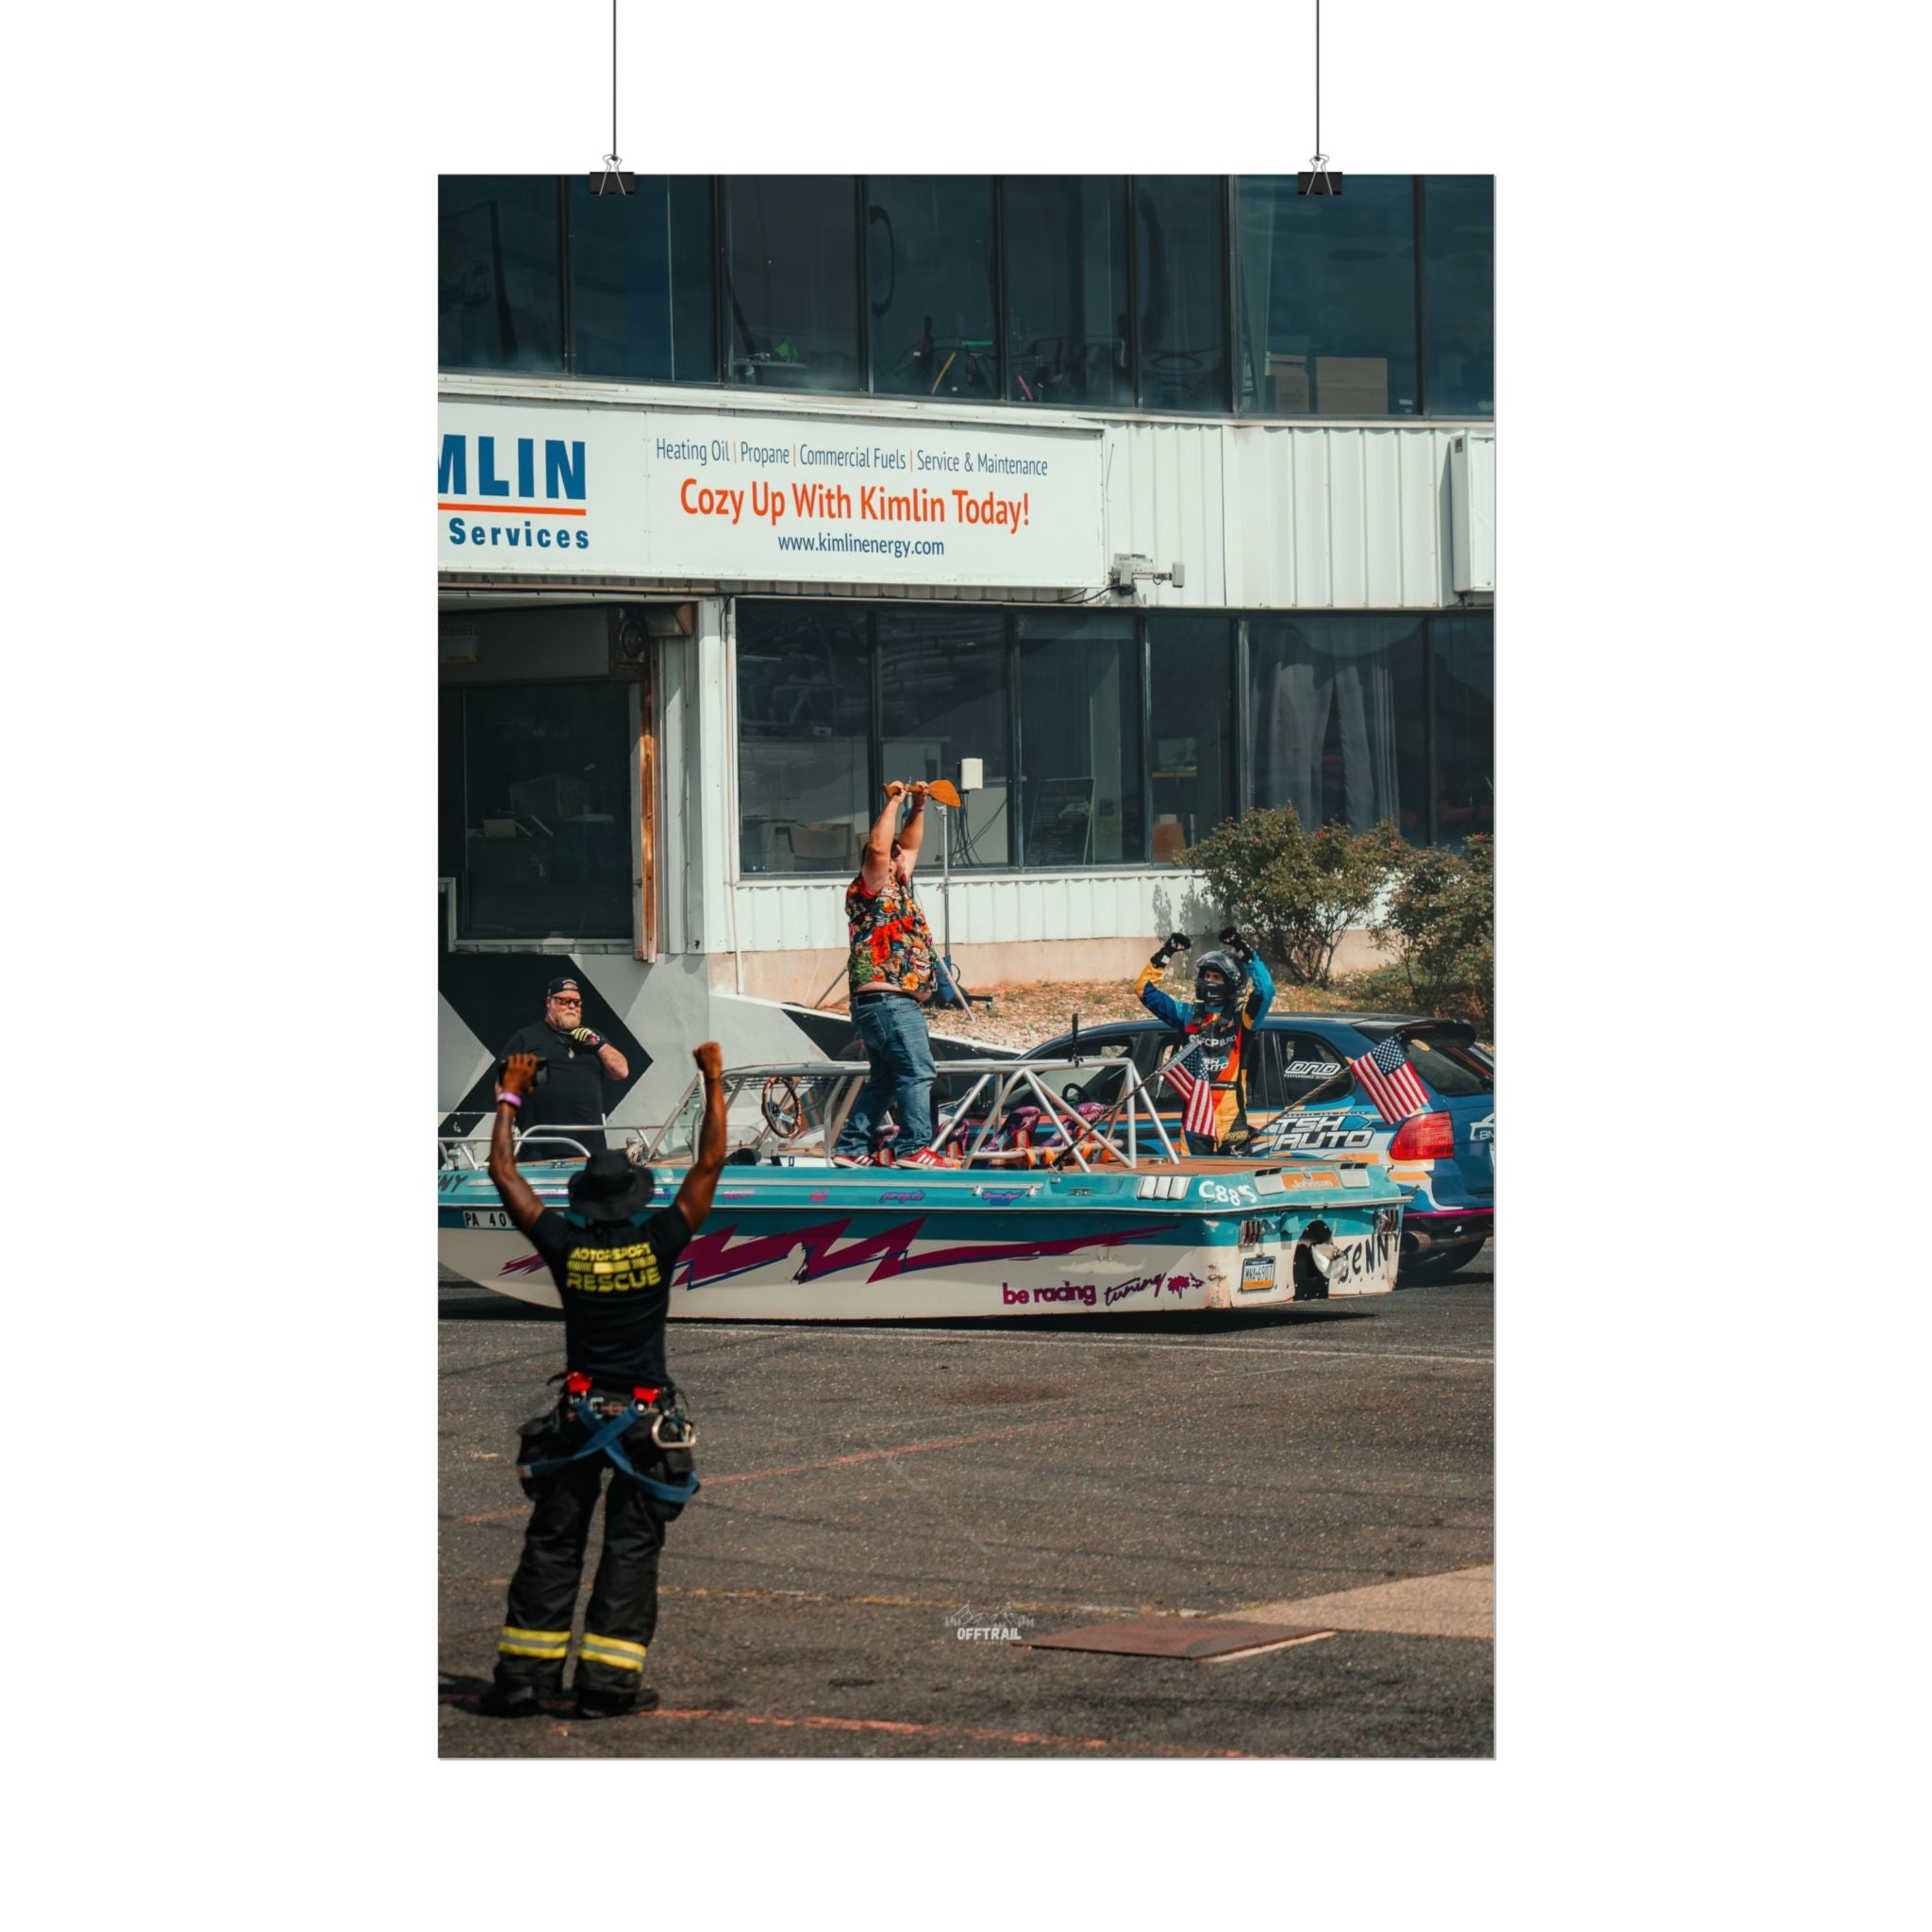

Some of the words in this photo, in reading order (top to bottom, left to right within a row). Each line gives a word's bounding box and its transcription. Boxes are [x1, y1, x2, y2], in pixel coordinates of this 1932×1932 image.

[657, 438, 707, 466] Heating
[711, 440, 730, 461] Oil
[741, 441, 790, 468] Propane
[800, 444, 870, 469] Commercial
[874, 447, 906, 470] Fuels
[917, 450, 959, 473] Service
[964, 452, 974, 473] &
[977, 453, 1048, 475] Maintenance
[680, 477, 744, 525] Cozy
[752, 481, 786, 526] Up
[791, 482, 852, 519] With
[860, 486, 945, 523] Kimlin
[952, 489, 1029, 535] Today!
[449, 518, 590, 549] Services
[778, 531, 944, 558] www.kimlinenergy.com
[1275, 1116, 1346, 1134] TSH
[1273, 1130, 1374, 1151] AUTO
[464, 1212, 480, 1227] PA
[566, 1266, 661, 1292] RESCUE
[1002, 1282, 1030, 1305] be
[1034, 1280, 1097, 1306] racing
[1103, 1273, 1168, 1307] tuning
